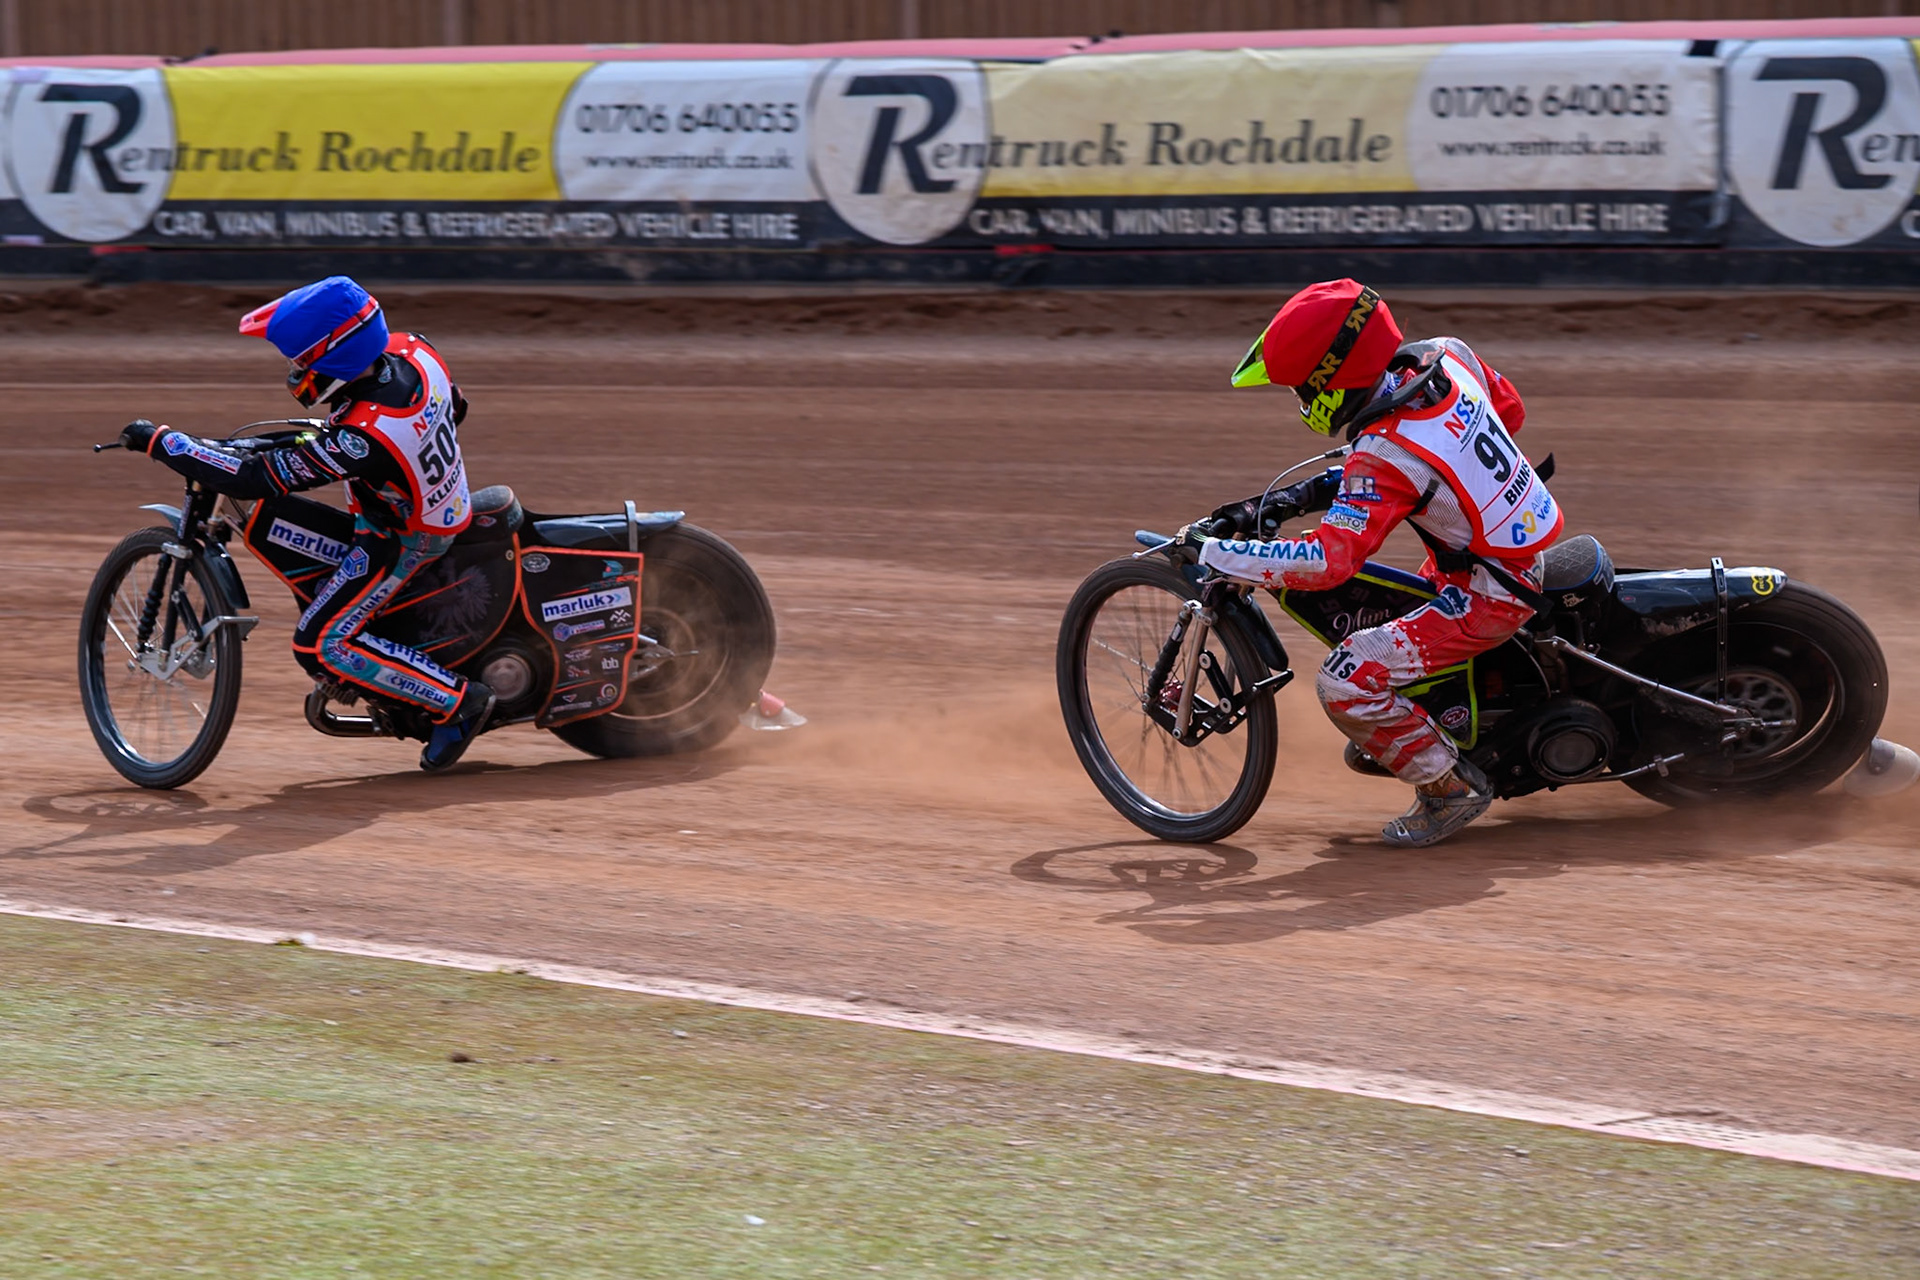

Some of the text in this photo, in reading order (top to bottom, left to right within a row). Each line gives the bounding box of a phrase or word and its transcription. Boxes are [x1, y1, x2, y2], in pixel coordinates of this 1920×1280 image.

[575, 103, 799, 133] 01706 640055
[1429, 84, 1672, 118] 01706 640055
[38, 83, 541, 194] Rentruck Rochdale
[841, 74, 1392, 195] Rentruck Rochdale
[285, 211, 398, 237] MINIBUS
[402, 211, 427, 237] &
[617, 213, 730, 239] VEHICLE
[732, 213, 799, 240] HIRE
[1112, 208, 1239, 235] MINIBUS
[1240, 206, 1267, 234] &
[1268, 206, 1474, 234] REFRIGERATED
[1474, 204, 1596, 232] VEHICLE
[1599, 203, 1670, 233] HIRE
[412, 385, 444, 437] NSSC
[1444, 384, 1479, 439] NSSC
[1474, 413, 1519, 484] 91
[1218, 539, 1325, 562] COLEMAN
[1332, 606, 1393, 638] Mum
